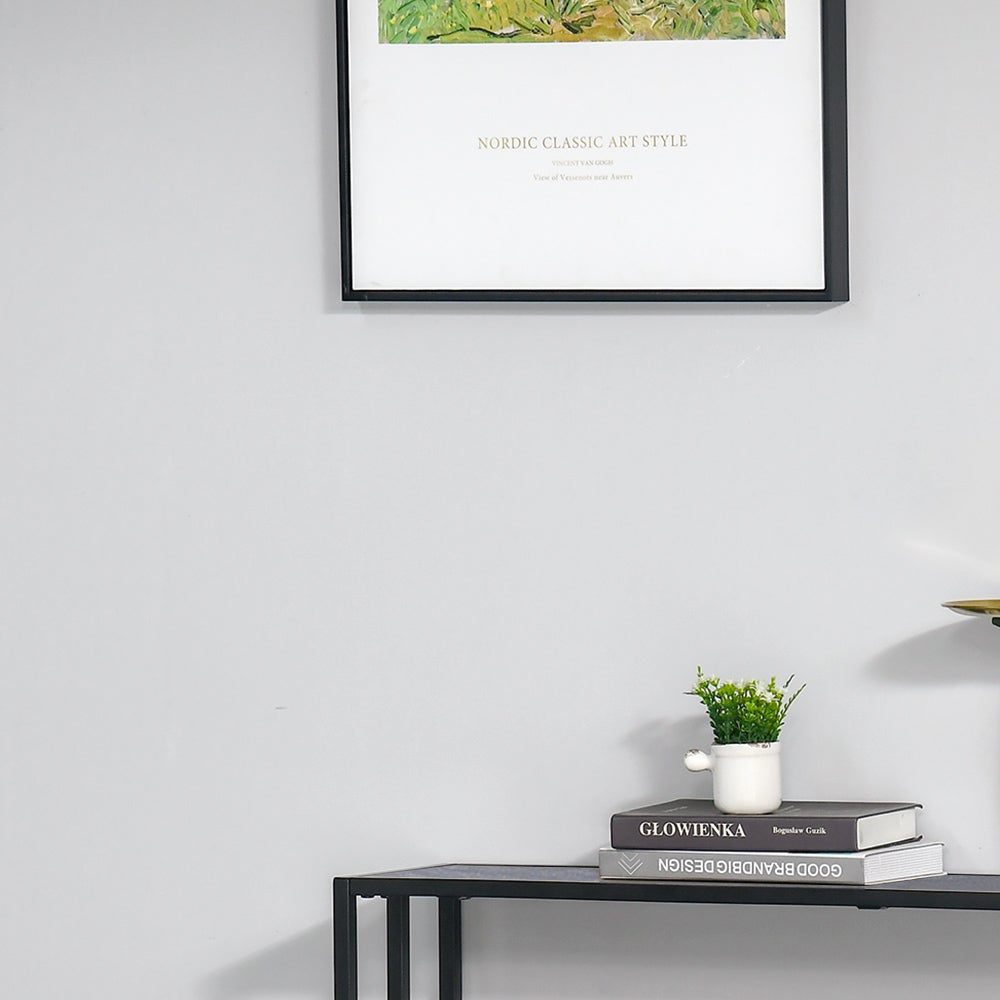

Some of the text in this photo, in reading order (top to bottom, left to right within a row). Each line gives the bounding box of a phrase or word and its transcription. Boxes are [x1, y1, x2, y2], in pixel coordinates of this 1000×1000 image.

[478, 135, 688, 149] NORDIC CLASSIC ART STYLE
[639, 821, 746, 837] GŁOWIENKA
[805, 827, 827, 835] Guzik
[658, 857, 714, 873] DESIGN
[797, 863, 842, 878] GOOD
